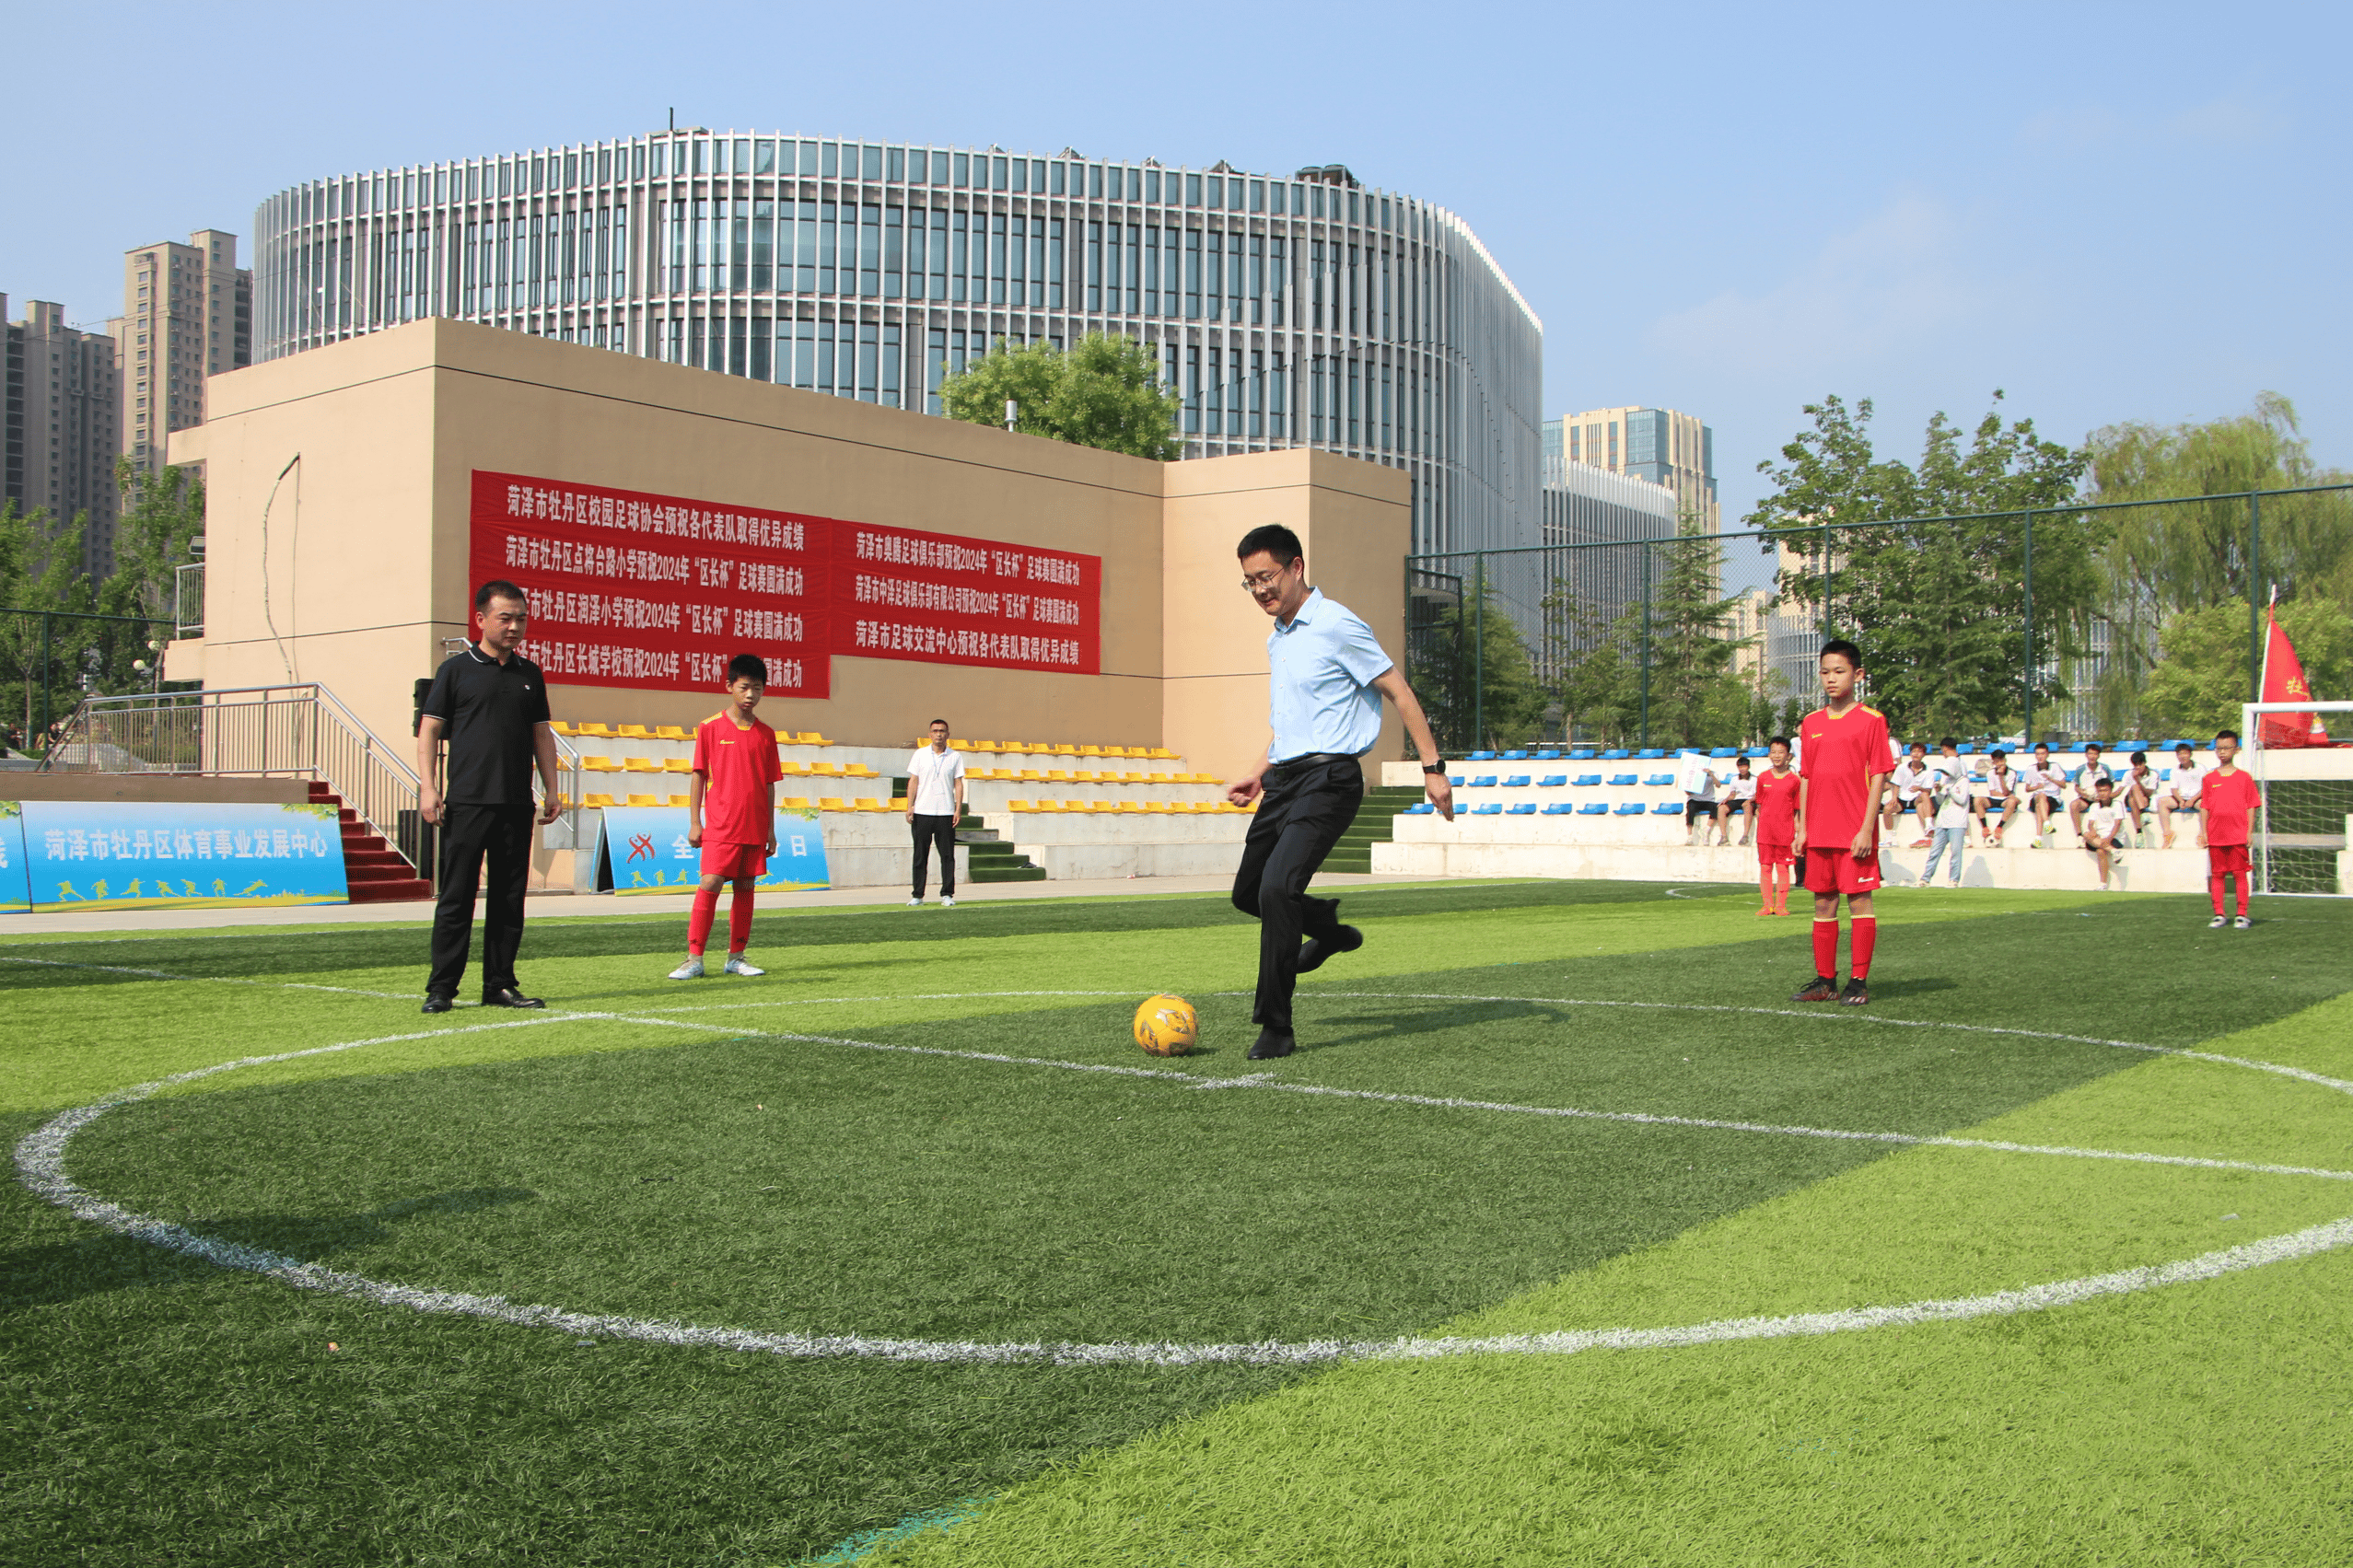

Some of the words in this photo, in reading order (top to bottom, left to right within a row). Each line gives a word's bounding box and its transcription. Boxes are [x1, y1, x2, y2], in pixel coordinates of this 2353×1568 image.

[507, 484, 804, 552] 菏泽市牡丹区校园足球协会预祝各代表队取得优异成绩
[856, 620, 1079, 665] 菏泽市足球交流中心预祝各代表队取得优异成绩
[44, 829, 328, 861] 菏泽市牡丹区体育事业发展中心
